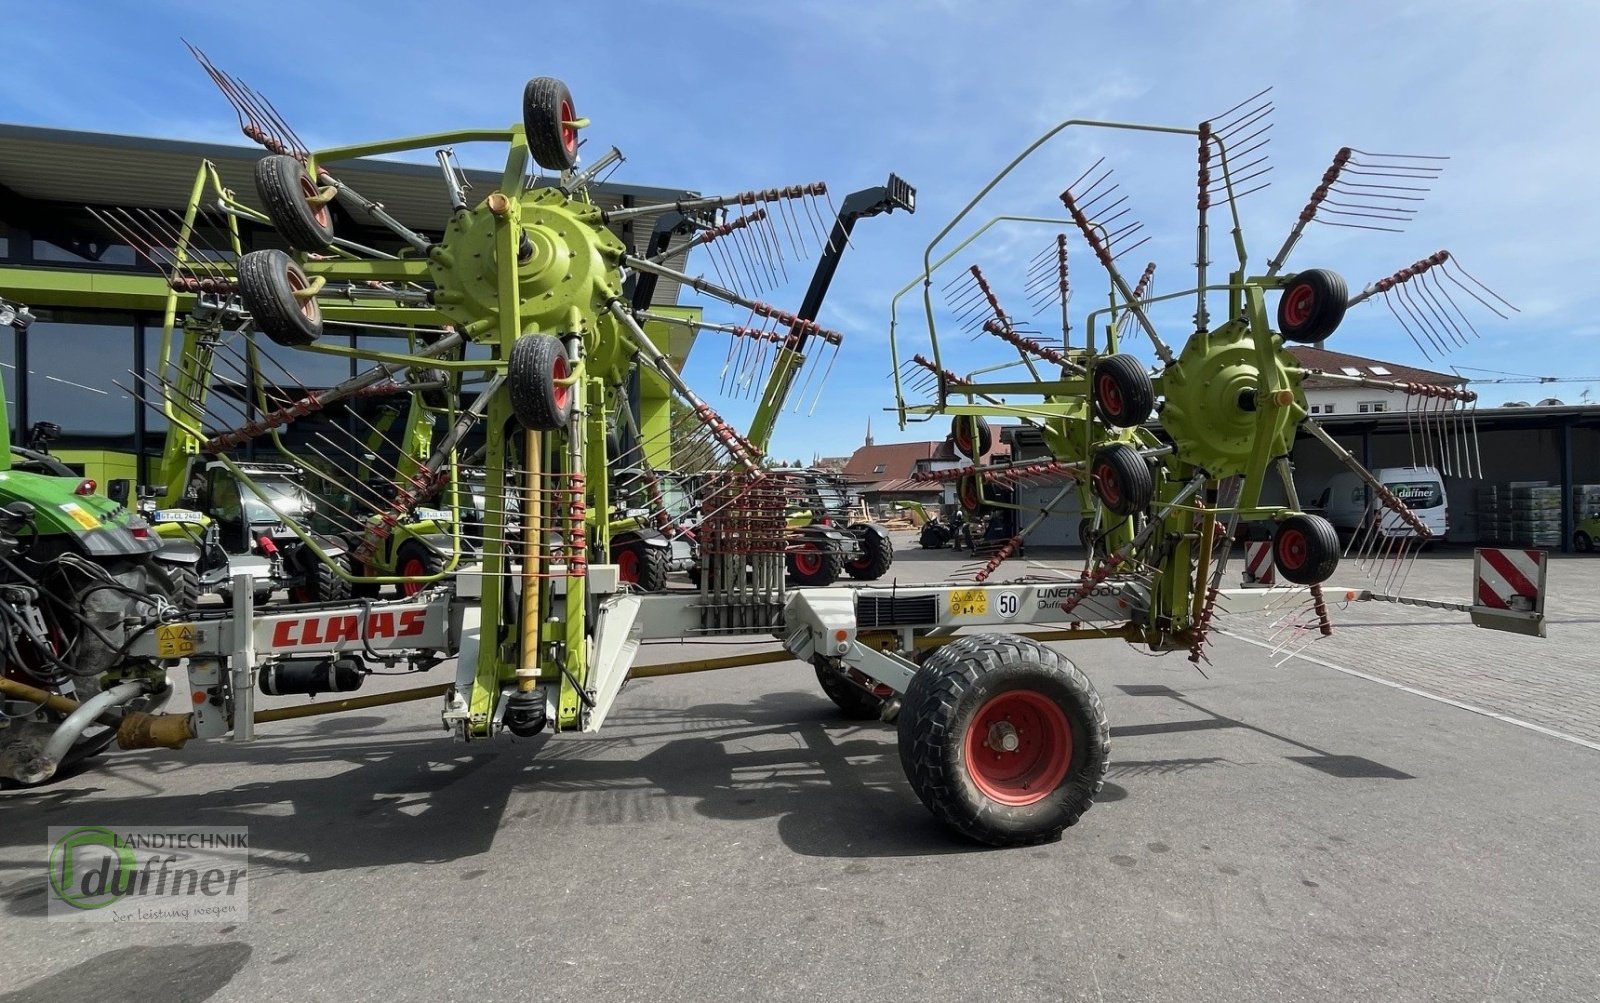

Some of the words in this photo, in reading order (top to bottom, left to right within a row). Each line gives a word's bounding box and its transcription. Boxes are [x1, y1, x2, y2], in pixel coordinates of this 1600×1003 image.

[1398, 488, 1434, 498] duffner
[1036, 587, 1077, 598] LINER
[1080, 586, 1122, 597] 000
[1000, 595, 1017, 615] 50
[271, 610, 428, 648] CLAAS
